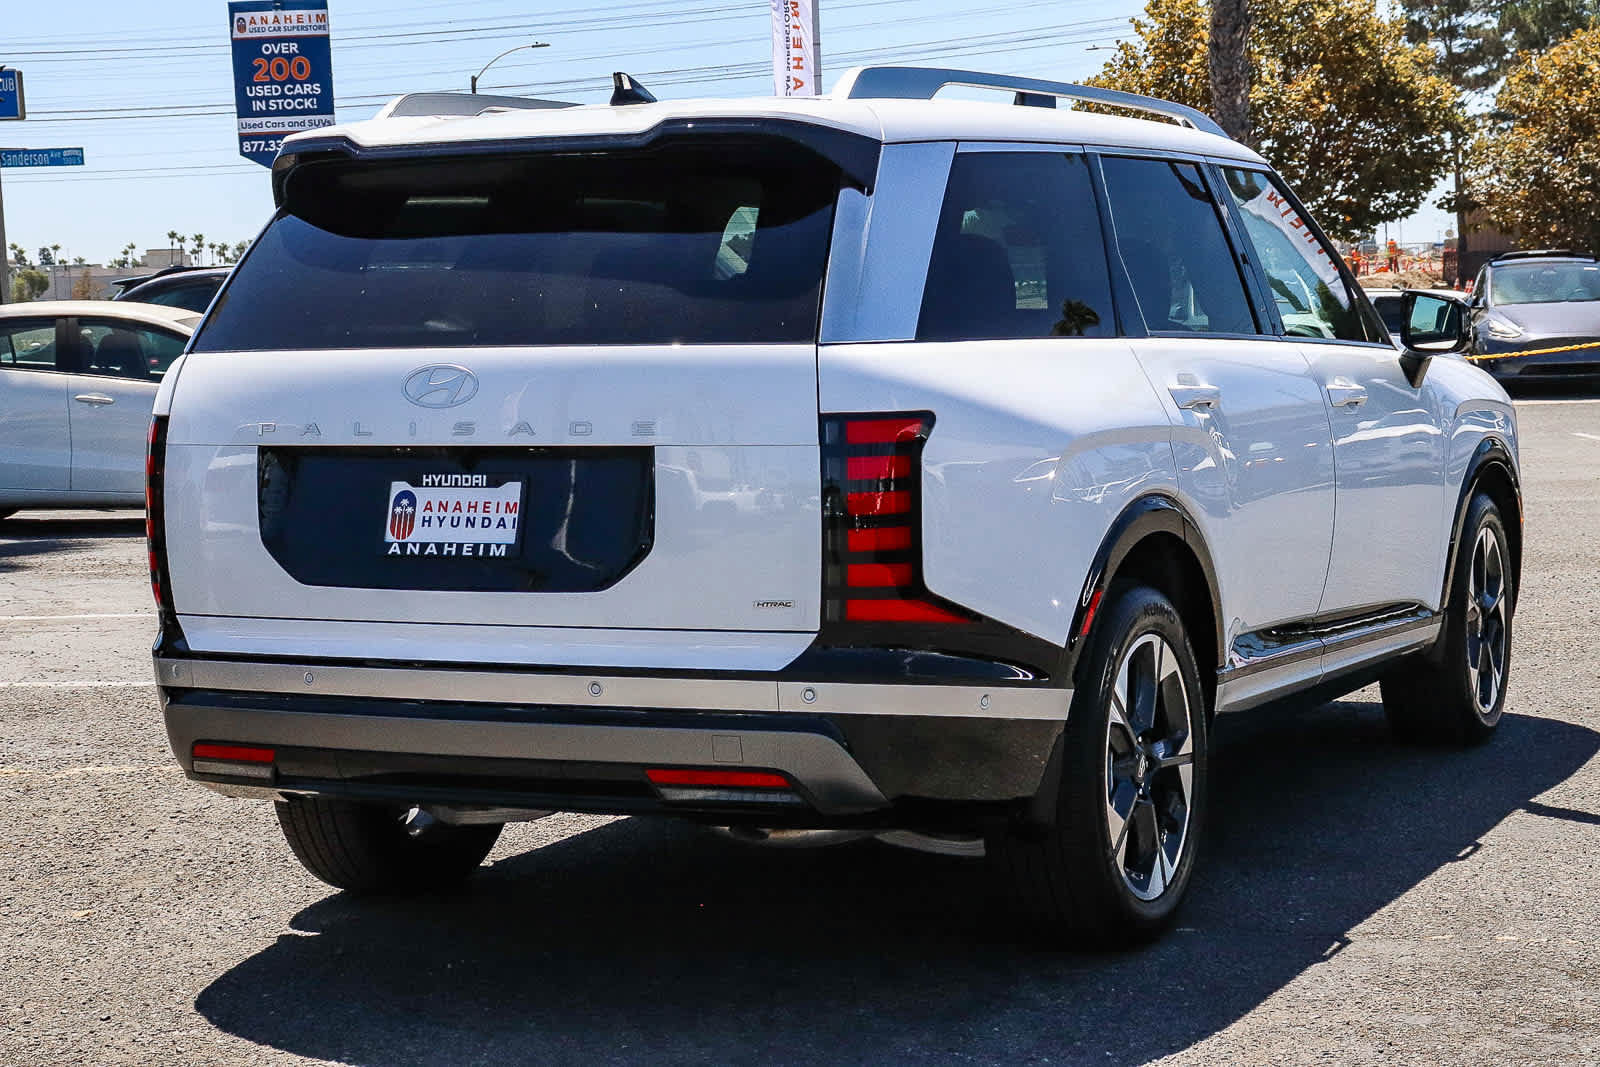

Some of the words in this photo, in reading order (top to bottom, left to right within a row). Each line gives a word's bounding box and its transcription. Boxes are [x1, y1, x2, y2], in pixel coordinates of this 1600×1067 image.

[249, 13, 327, 25] ANAHEIM
[248, 25, 266, 33] USED
[262, 43, 299, 54] OVER
[252, 56, 311, 82] 200
[246, 85, 281, 97] USED
[284, 83, 321, 95] CARS
[252, 100, 266, 111] IN
[268, 98, 317, 111] STOCK!
[240, 120, 263, 130] Used
[265, 120, 285, 129] Cars
[287, 119, 306, 127] and
[308, 118, 331, 127] SUVs
[1, 152, 49, 166] Sanderson
[257, 421, 657, 437] PALISADE
[422, 474, 487, 487] HYUNDAI
[423, 500, 518, 514] ANAHEIM
[421, 516, 517, 529] HYUNDAI
[388, 542, 508, 557] ANAHEIM
